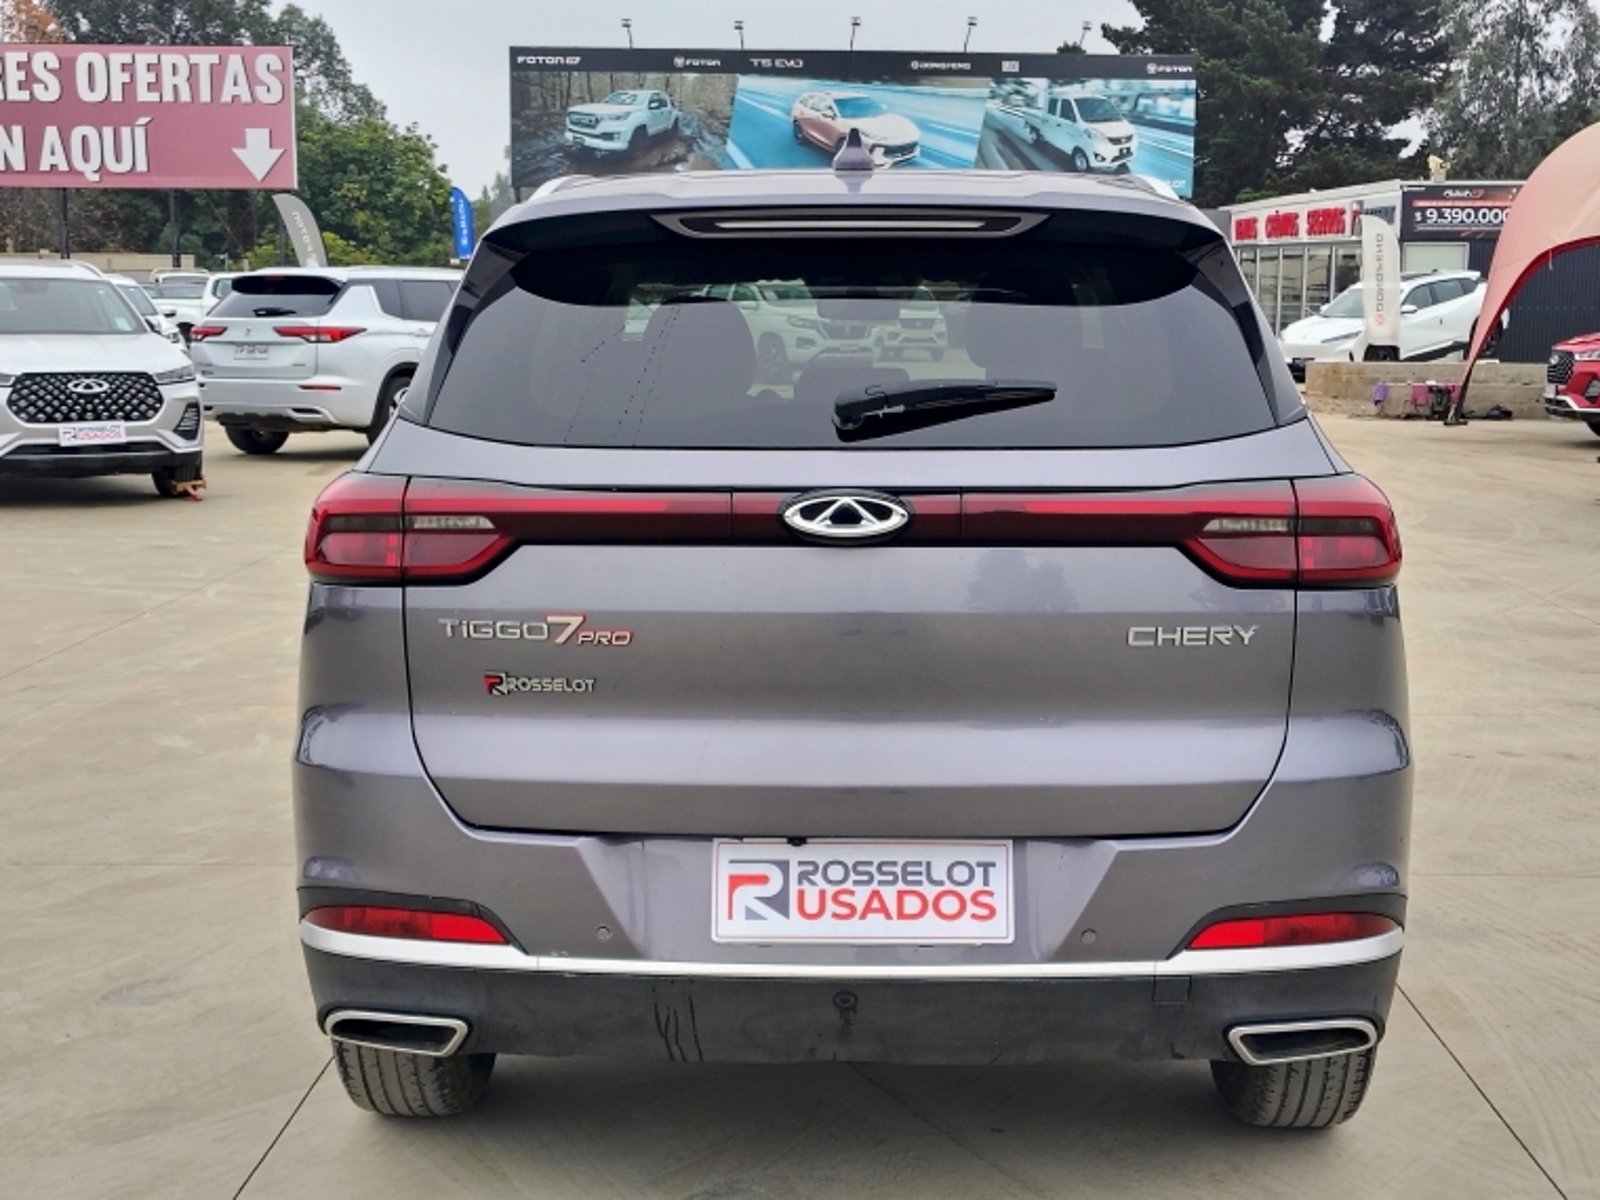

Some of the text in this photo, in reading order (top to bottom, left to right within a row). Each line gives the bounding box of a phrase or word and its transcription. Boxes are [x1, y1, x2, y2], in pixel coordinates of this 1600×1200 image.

[517, 56, 564, 64] FOTON
[0, 51, 284, 104] ES OFERTAS
[39, 117, 152, 182] AQUÍ
[1127, 624, 1260, 648] CHERY
[796, 859, 997, 887] ROSSELOT
[796, 887, 998, 922] USADOS
